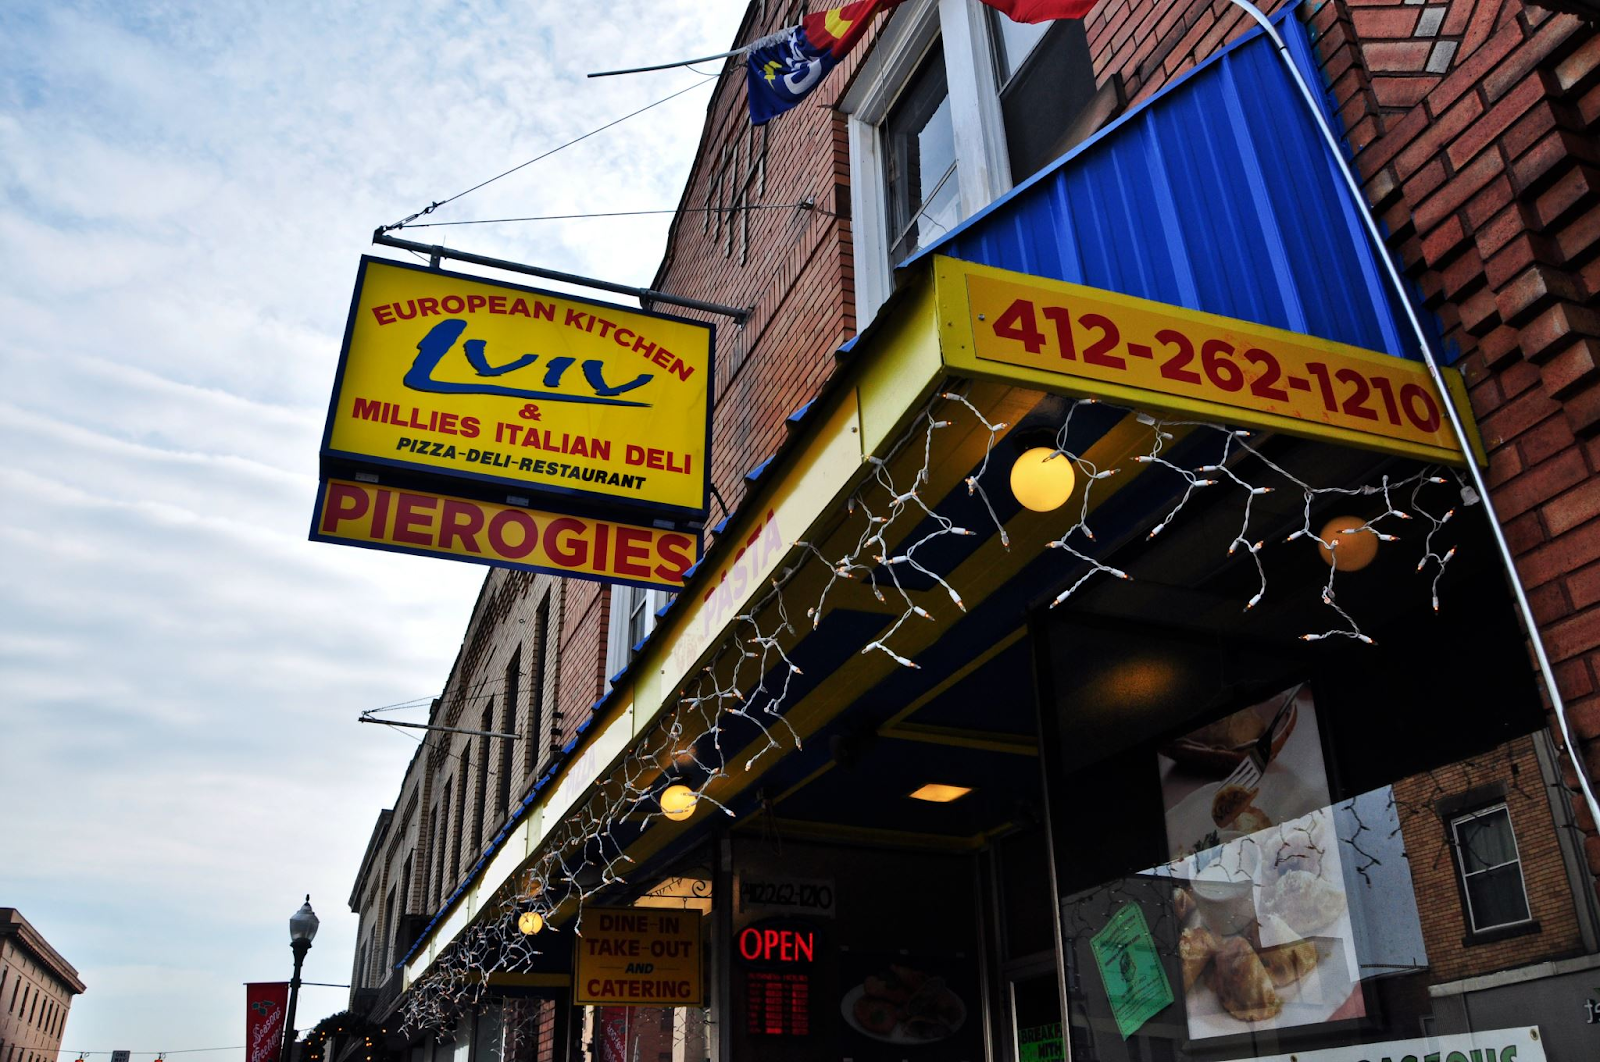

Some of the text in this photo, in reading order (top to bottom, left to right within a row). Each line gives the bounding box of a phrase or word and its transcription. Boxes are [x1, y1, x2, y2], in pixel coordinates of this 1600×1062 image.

[372, 295, 696, 382] EUROPEAN KITCHEN
[992, 299, 1442, 434] 412-262-1210
[518, 403, 542, 422] &
[351, 397, 692, 475] MILLIES ITALIAN DELI
[396, 437, 646, 490] PIZZA-DELI-RESTAURANT
[322, 482, 694, 583] PIEROGIES
[702, 508, 783, 637] PASTA
[599, 914, 680, 934] DINE-IN
[740, 927, 814, 962] OPEN
[586, 938, 693, 958] TAKE-OUT
[625, 963, 654, 974] AND
[587, 979, 691, 998] CATERING
